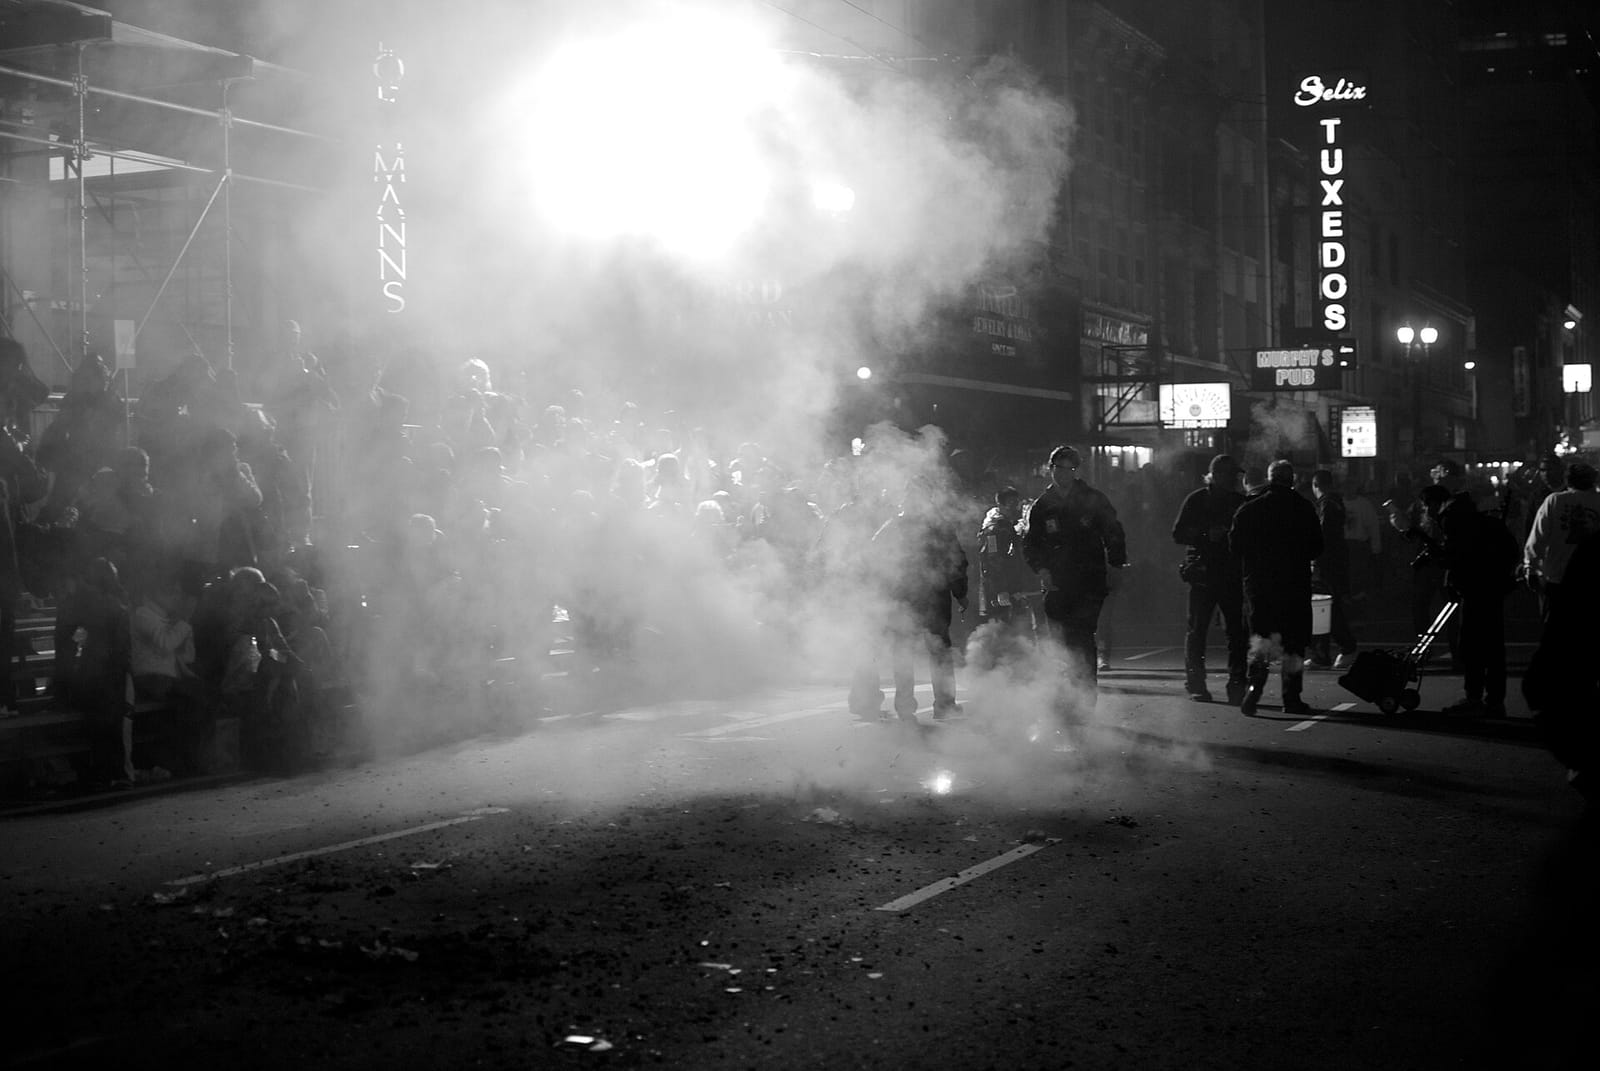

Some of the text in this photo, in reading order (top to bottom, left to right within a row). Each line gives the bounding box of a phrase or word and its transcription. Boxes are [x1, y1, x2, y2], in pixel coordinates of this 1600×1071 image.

[1293, 75, 1367, 107] Selix
[1319, 118, 1348, 331] TUXEDOS
[1256, 349, 1334, 368] MURPHYS
[1275, 368, 1316, 386] PUB
